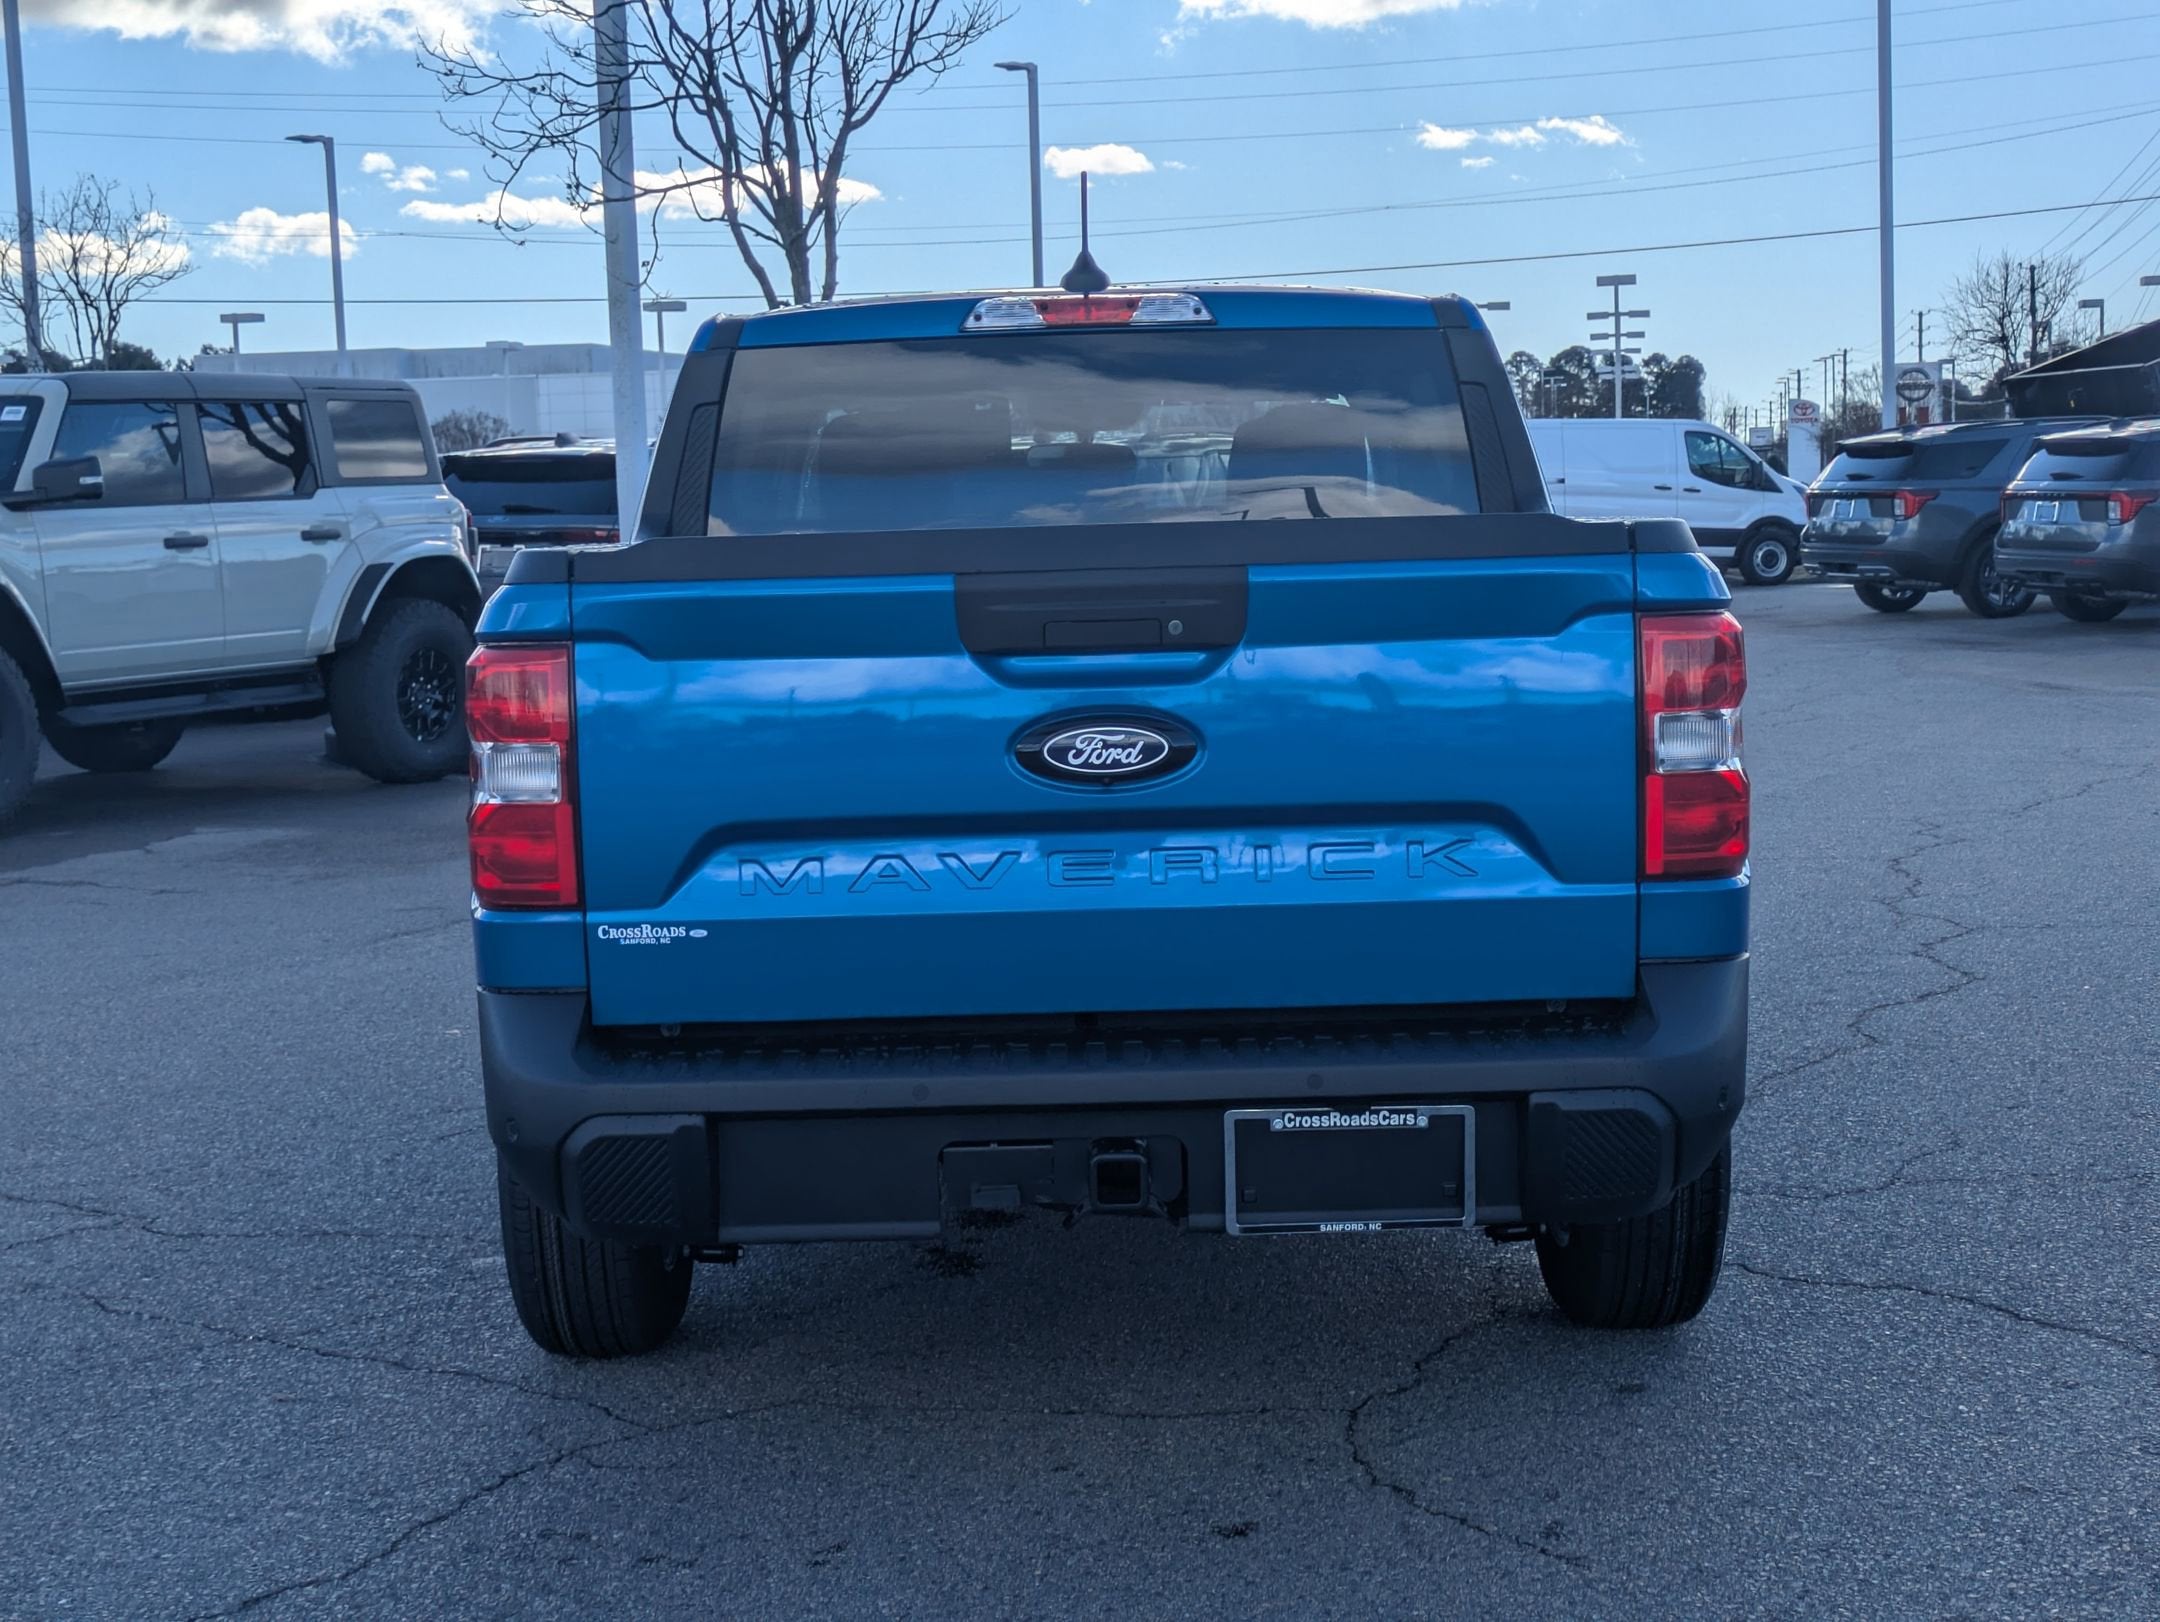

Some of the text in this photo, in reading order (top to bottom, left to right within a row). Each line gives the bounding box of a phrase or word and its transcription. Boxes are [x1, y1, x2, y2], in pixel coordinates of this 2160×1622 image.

[1067, 734, 1144, 765] Ford
[738, 837, 1479, 896] MAVERICK
[1284, 1110, 1415, 1128] CrossRoadsCars
[1369, 1222, 1382, 1230] NC
